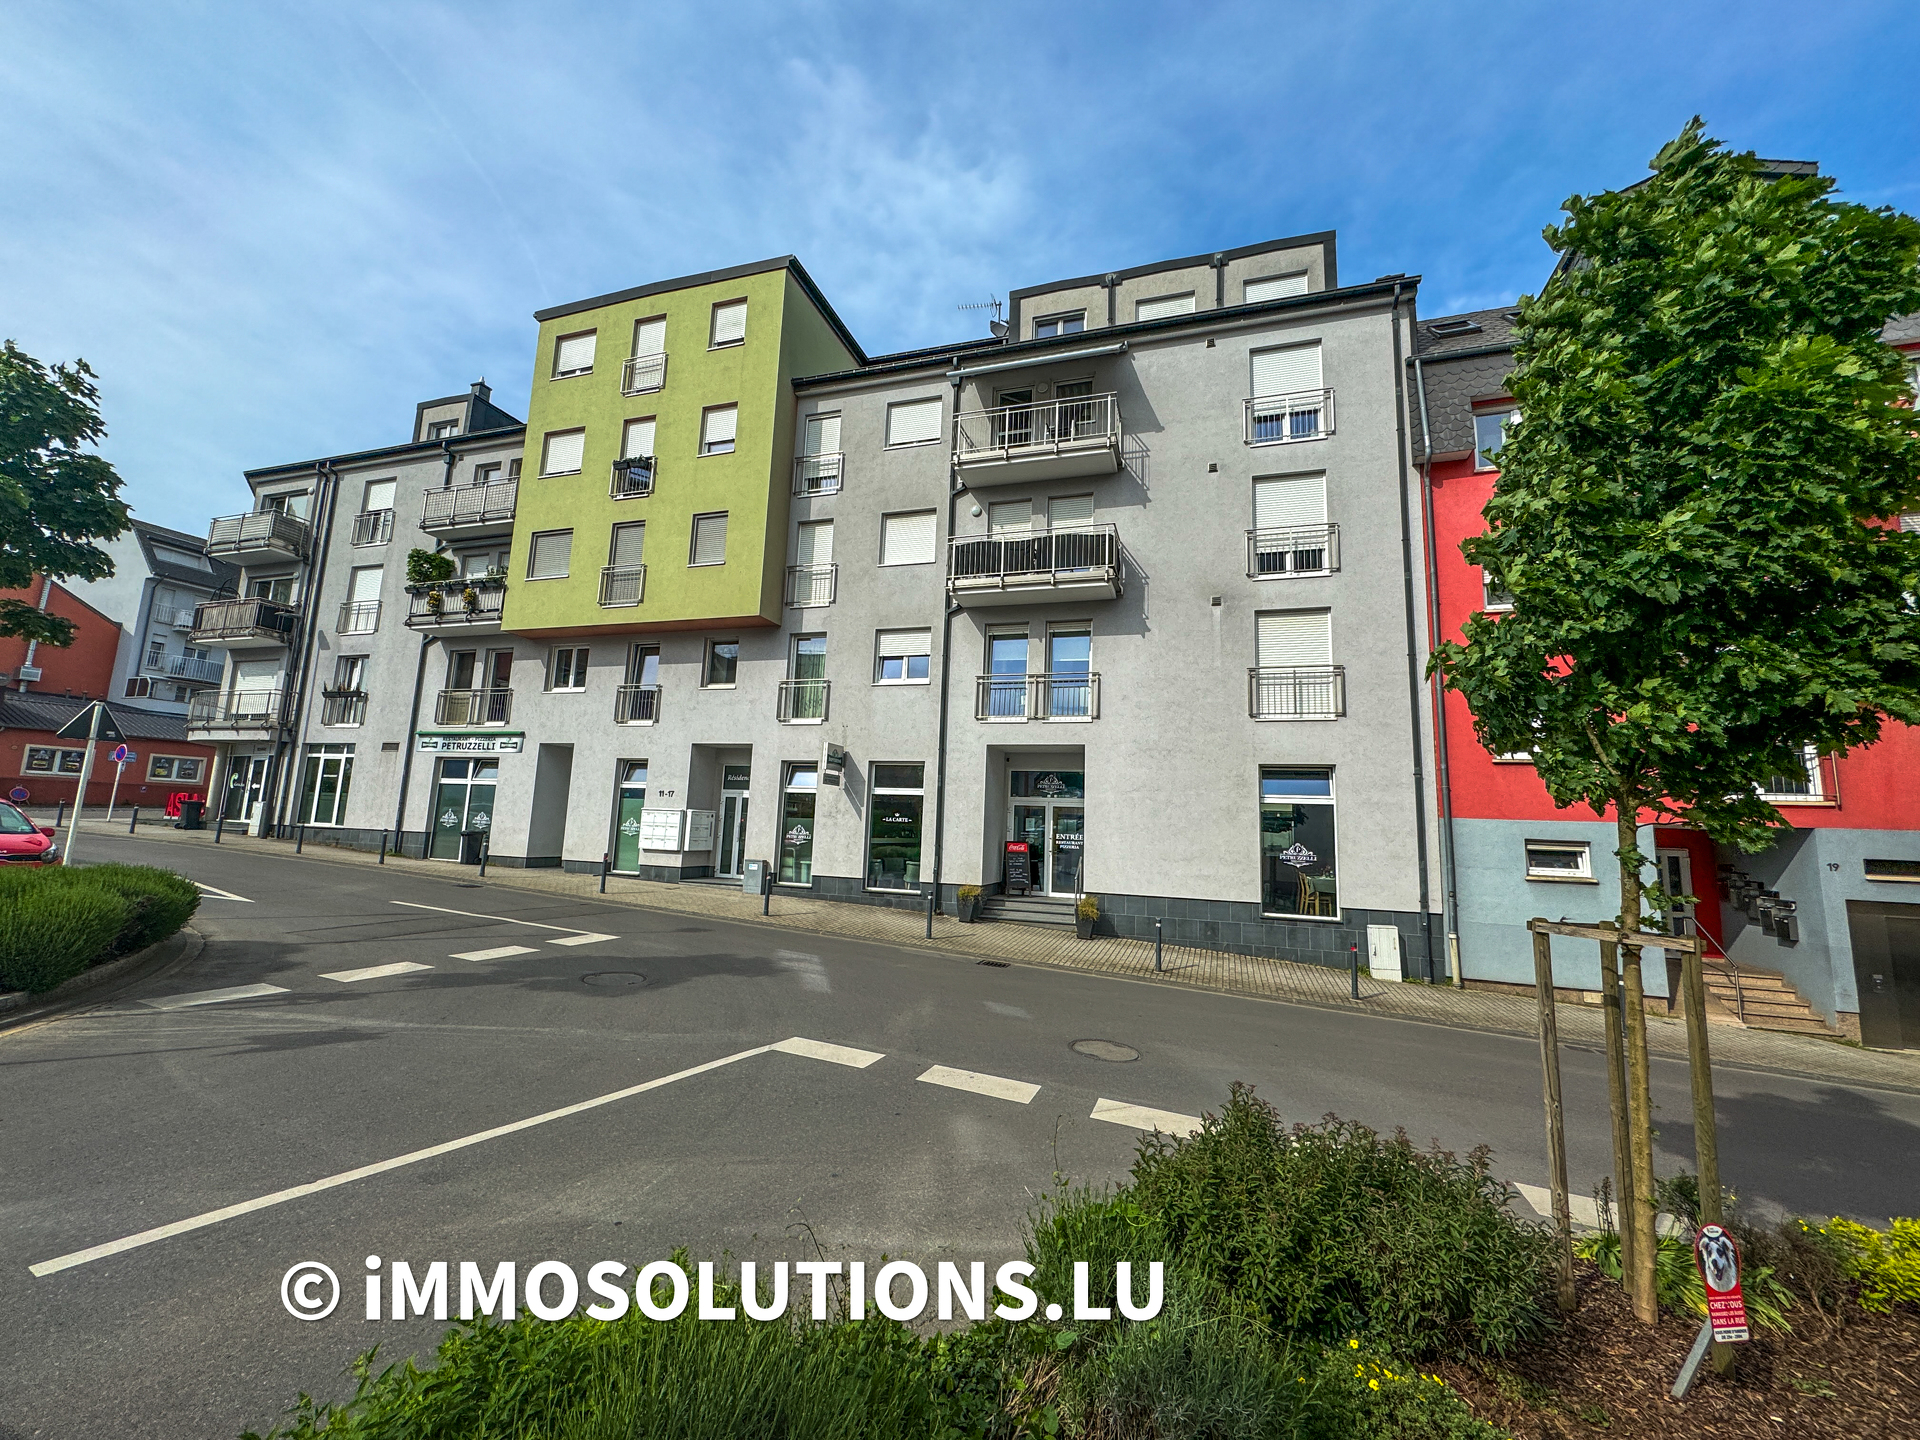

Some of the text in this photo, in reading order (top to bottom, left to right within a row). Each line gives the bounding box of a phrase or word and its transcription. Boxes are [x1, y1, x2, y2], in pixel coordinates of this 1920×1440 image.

[442, 742, 496, 750] PETRUZZELLI
[1827, 863, 1839, 871] 19
[1710, 1301, 1725, 1309] CHEZ
